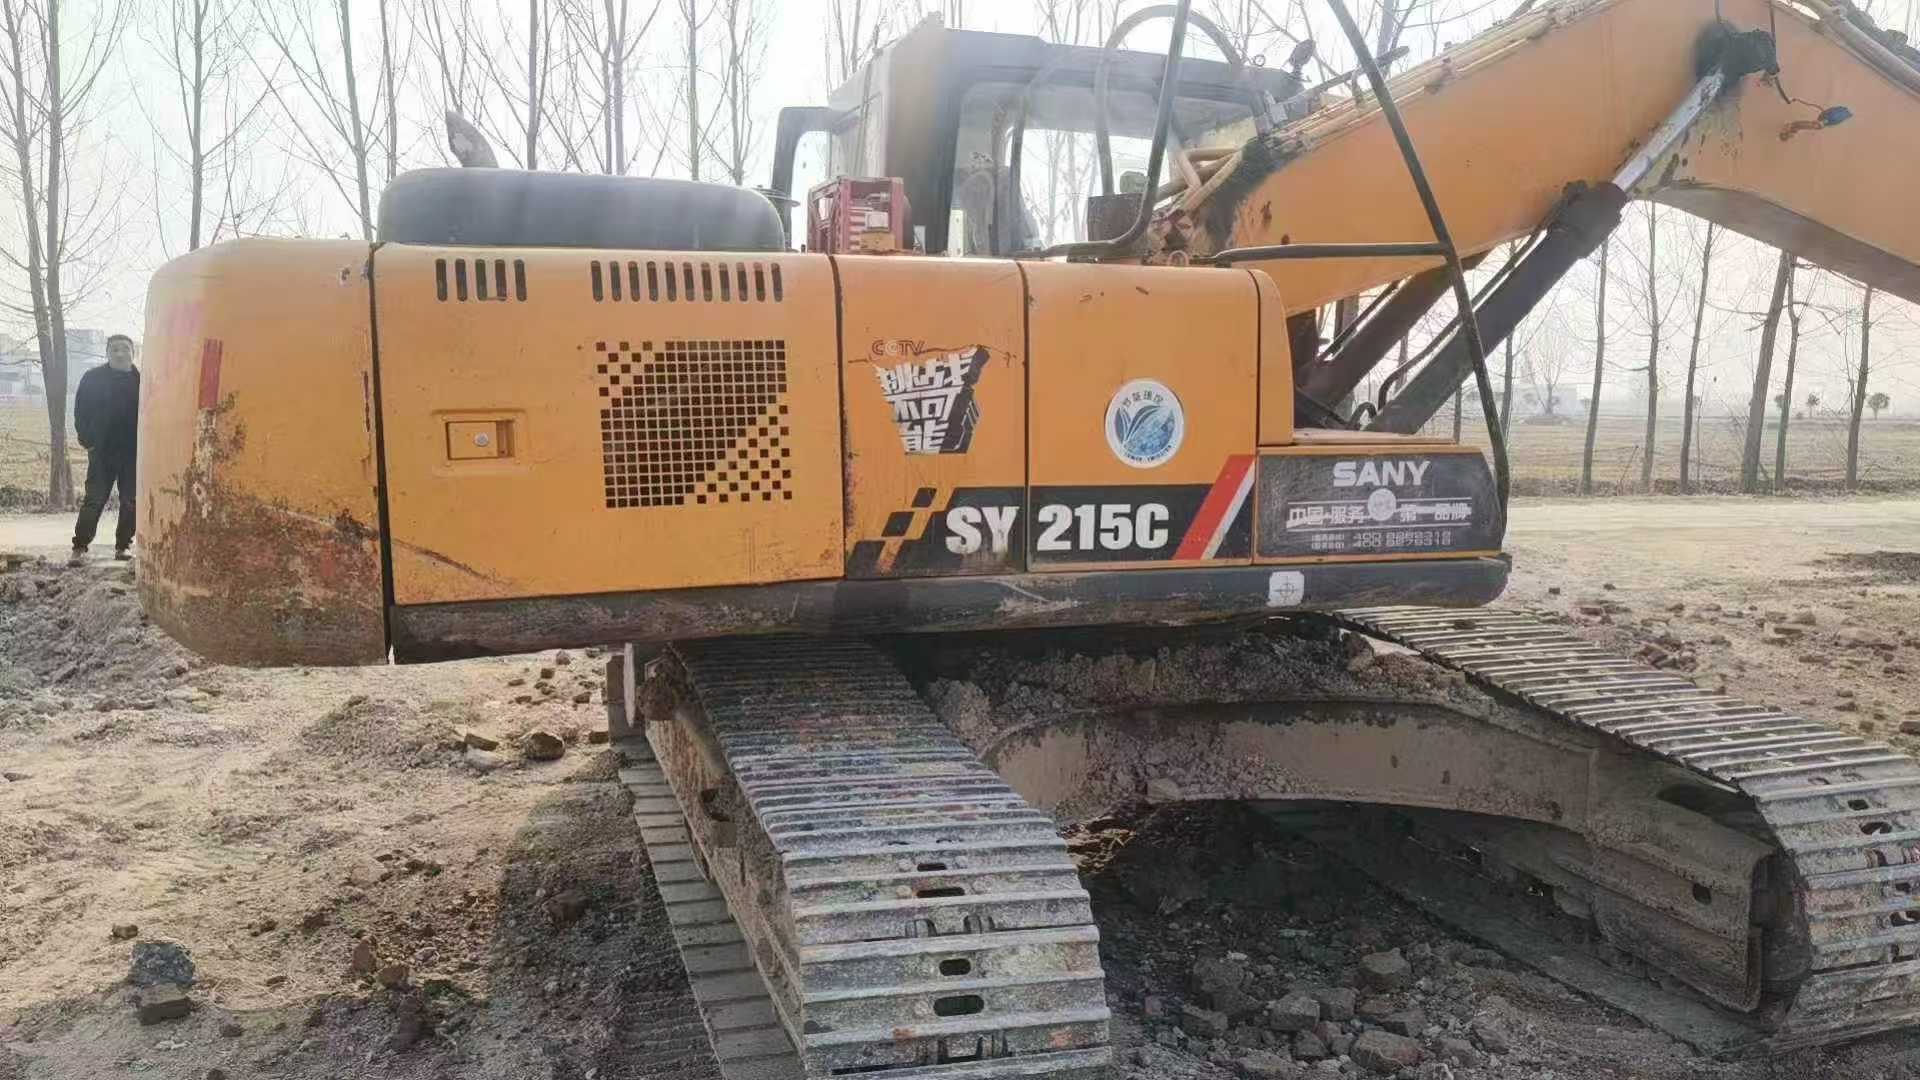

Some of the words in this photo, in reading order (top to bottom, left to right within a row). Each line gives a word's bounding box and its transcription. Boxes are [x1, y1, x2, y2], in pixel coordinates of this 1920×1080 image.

[875, 348, 978, 394] 挑战
[884, 386, 962, 421] 不可
[899, 420, 949, 454] 能
[1333, 461, 1431, 487] SANY
[945, 505, 1020, 555] SY
[1036, 503, 1170, 551] 215C
